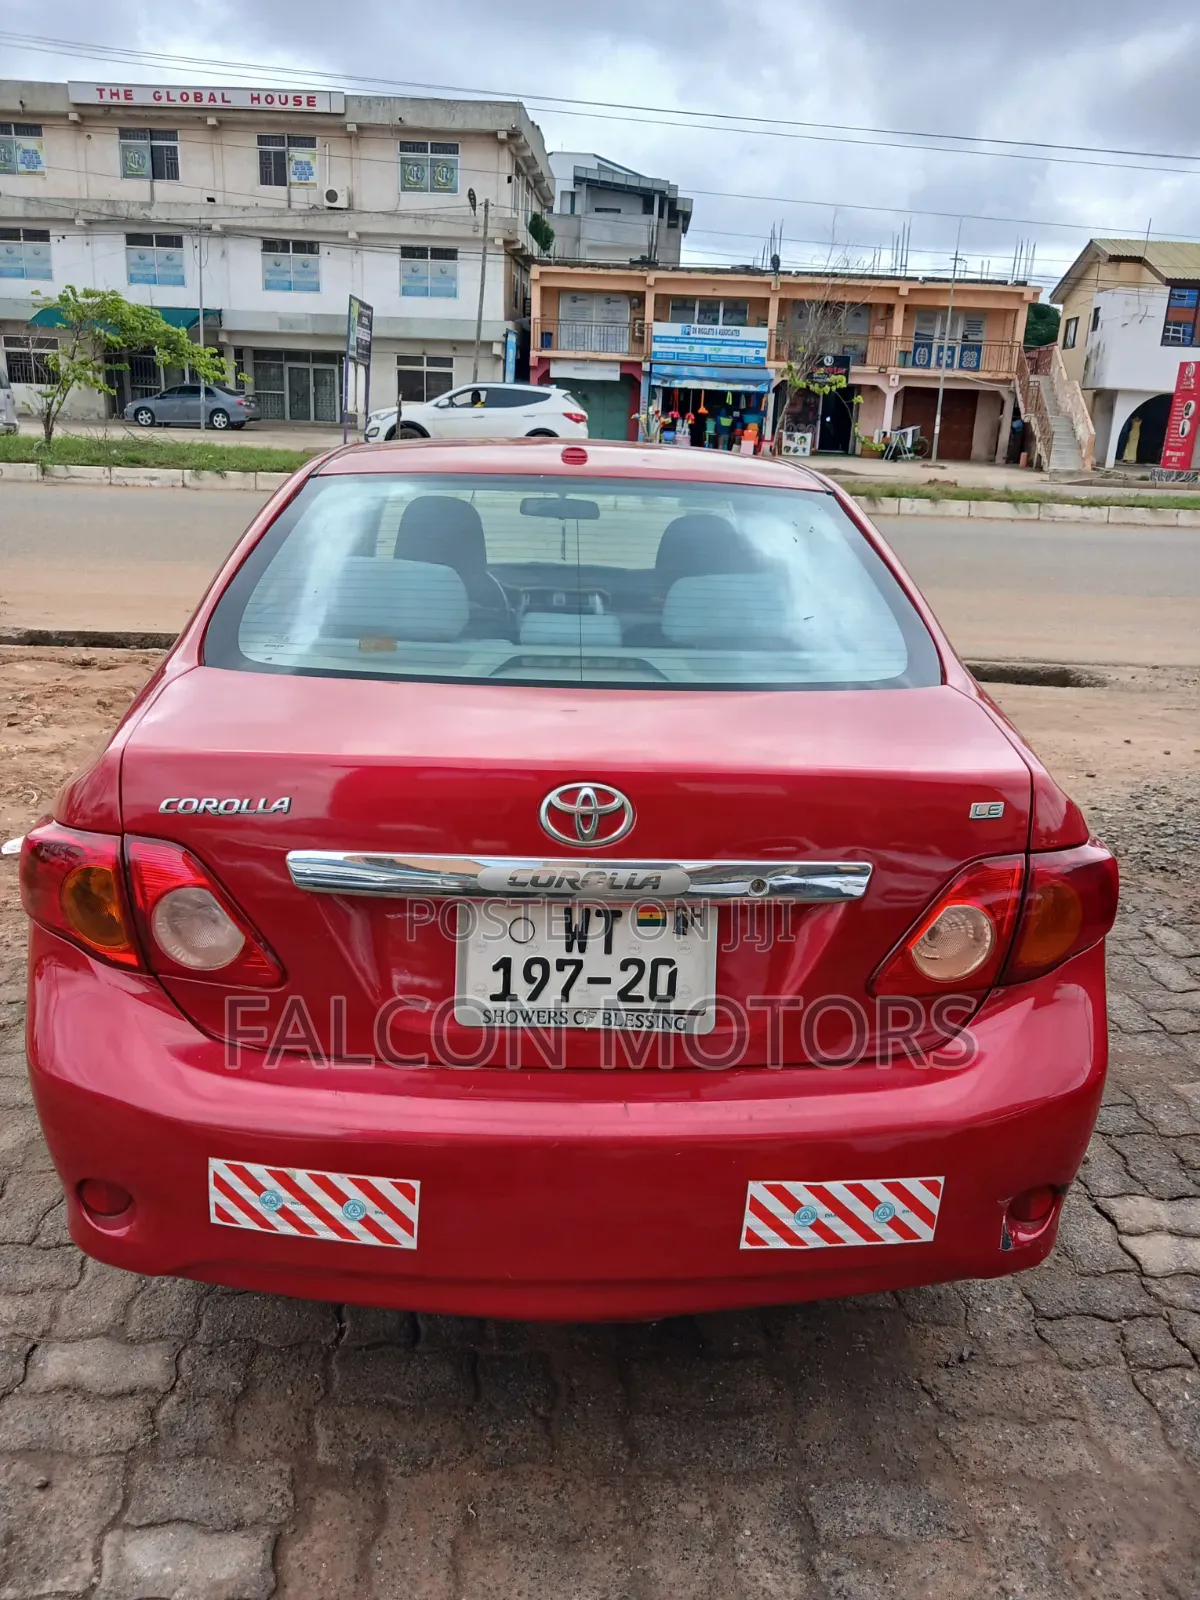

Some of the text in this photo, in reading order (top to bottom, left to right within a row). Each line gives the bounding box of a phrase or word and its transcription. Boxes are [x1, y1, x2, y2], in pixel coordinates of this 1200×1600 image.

[96, 87, 317, 107] THE GLOBAL HOUSE
[158, 797, 291, 815] COROLLA
[973, 803, 1003, 816] LE
[507, 868, 662, 890] COROLLA
[563, 907, 623, 954] WT
[489, 956, 678, 1002] 197-20
[482, 1009, 569, 1025] SHOWERS
[601, 1012, 687, 1032] BLESSING
